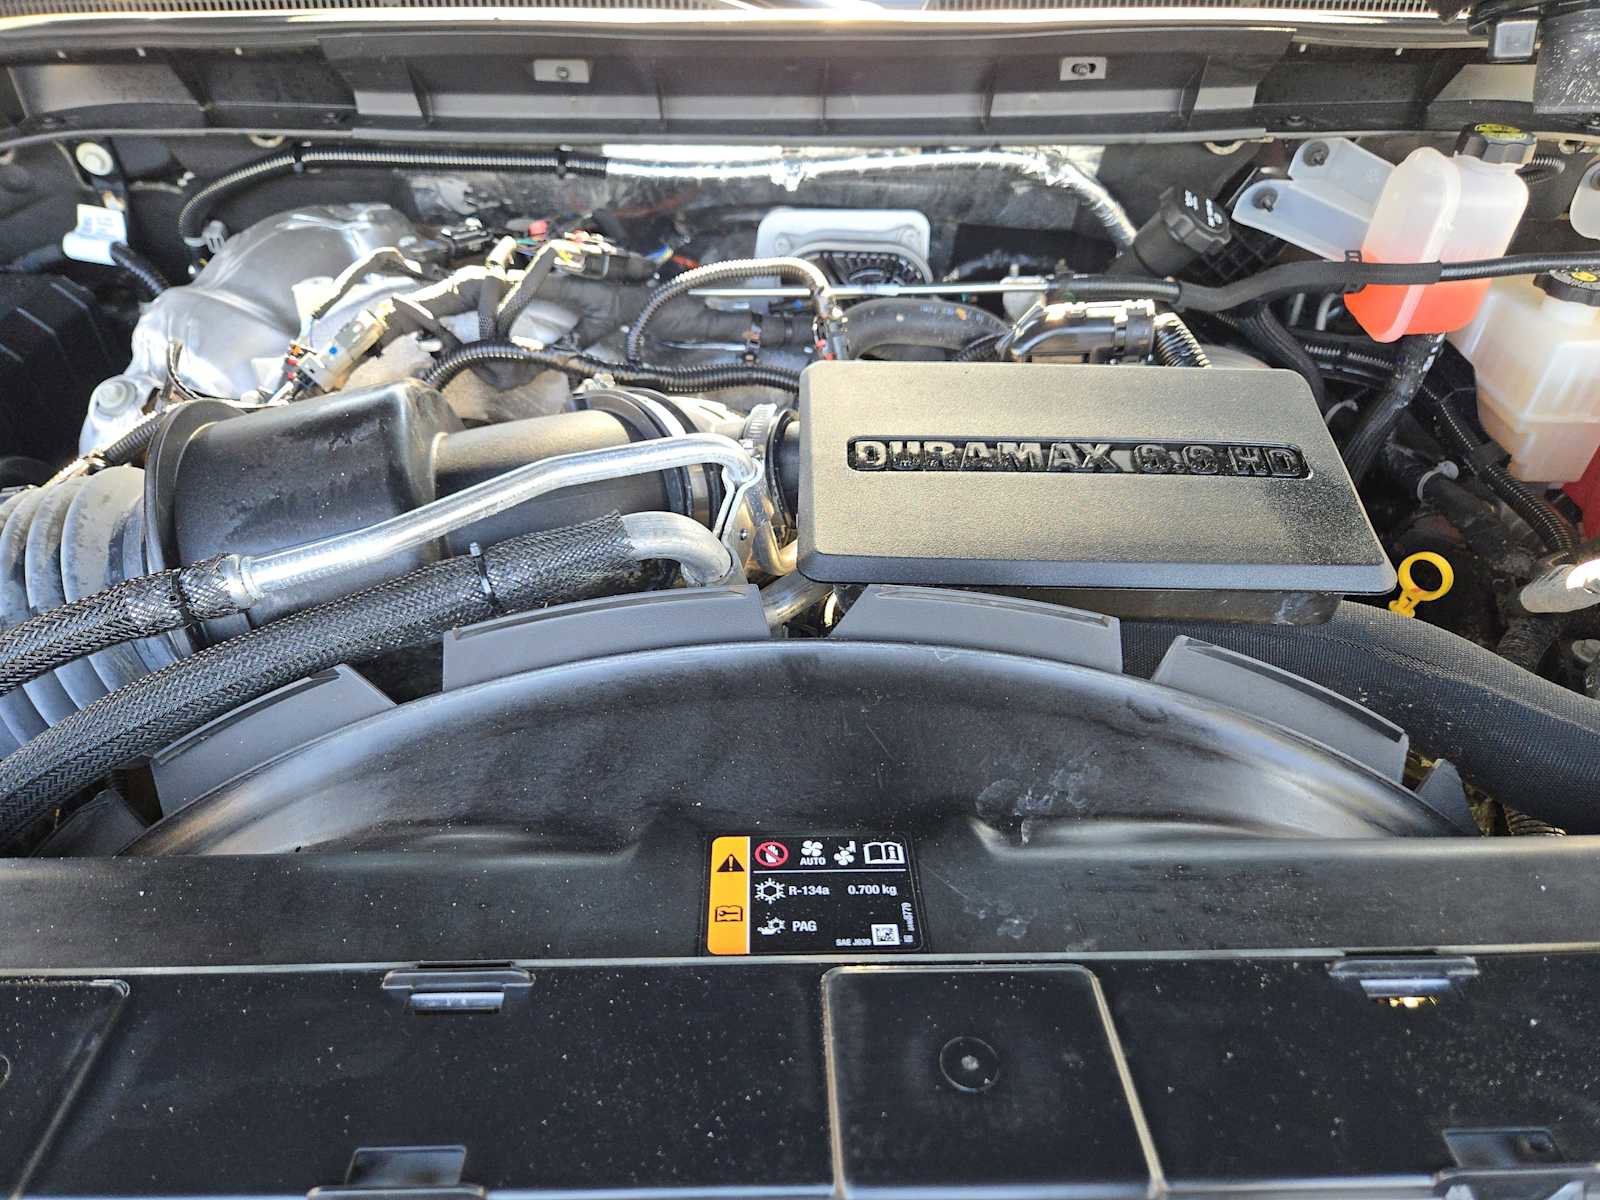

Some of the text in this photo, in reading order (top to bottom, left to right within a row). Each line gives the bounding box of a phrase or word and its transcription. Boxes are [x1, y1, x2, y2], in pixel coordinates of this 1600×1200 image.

[854, 440, 1303, 477] DURAMAX 6.6 HD
[800, 856, 826, 866] AUTO
[788, 884, 830, 896] R-134a
[847, 884, 898, 897] 0.700 kg
[792, 921, 818, 932] PAG
